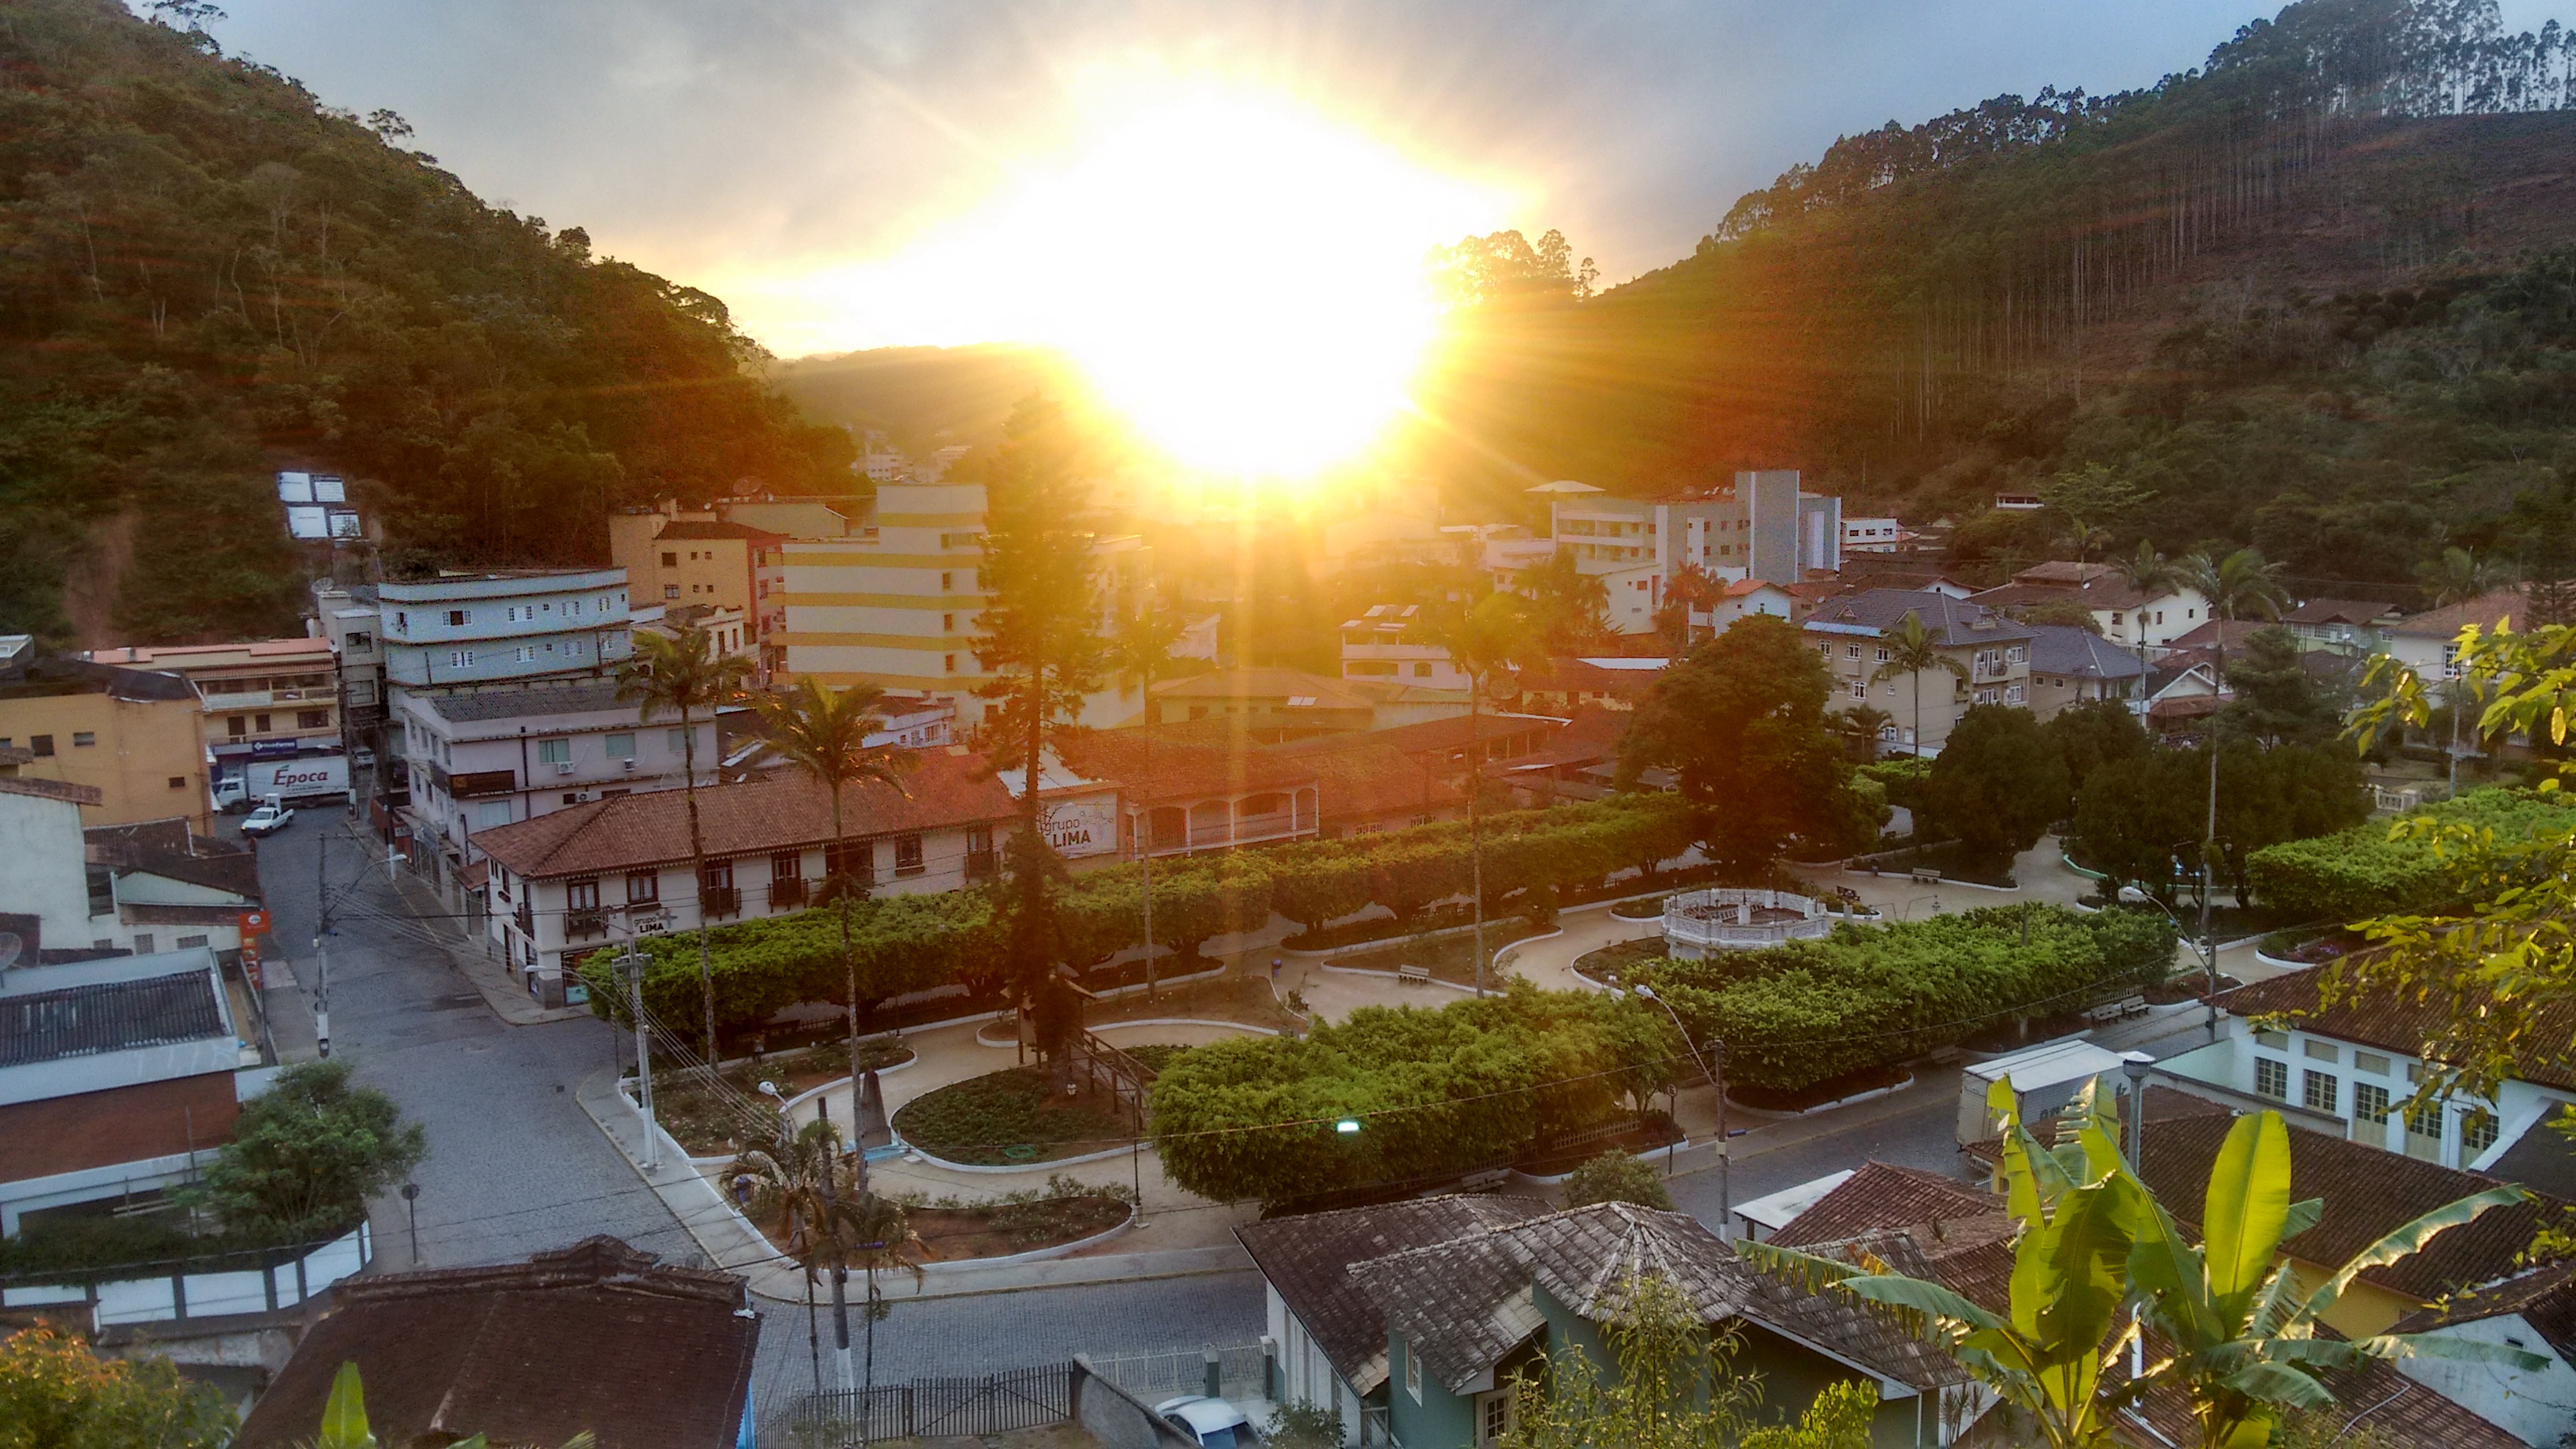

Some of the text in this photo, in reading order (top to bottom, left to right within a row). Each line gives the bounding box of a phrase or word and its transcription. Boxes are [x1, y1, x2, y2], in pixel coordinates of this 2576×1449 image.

[273, 764, 328, 788] Época
[1045, 818, 1080, 836] grupo
[1053, 829, 1091, 848] LIMA
[634, 916, 657, 927] grupo
[639, 923, 665, 933] LIMA
